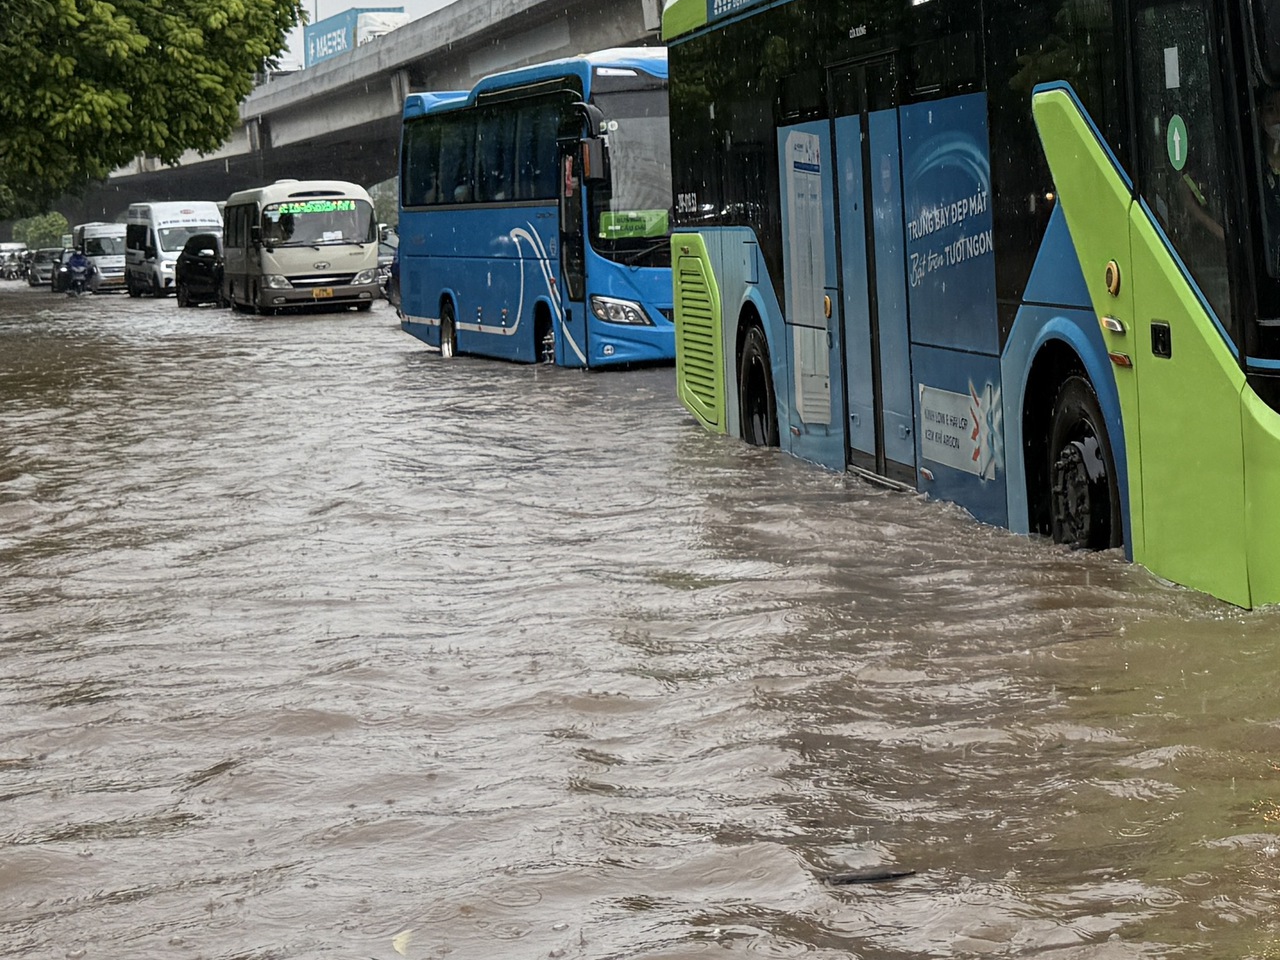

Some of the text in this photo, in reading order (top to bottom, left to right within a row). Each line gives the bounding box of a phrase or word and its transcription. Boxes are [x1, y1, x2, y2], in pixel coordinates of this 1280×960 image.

[316, 27, 348, 58] MAERSK
[951, 199, 968, 227] ĐẸP
[966, 229, 993, 259] NGON
